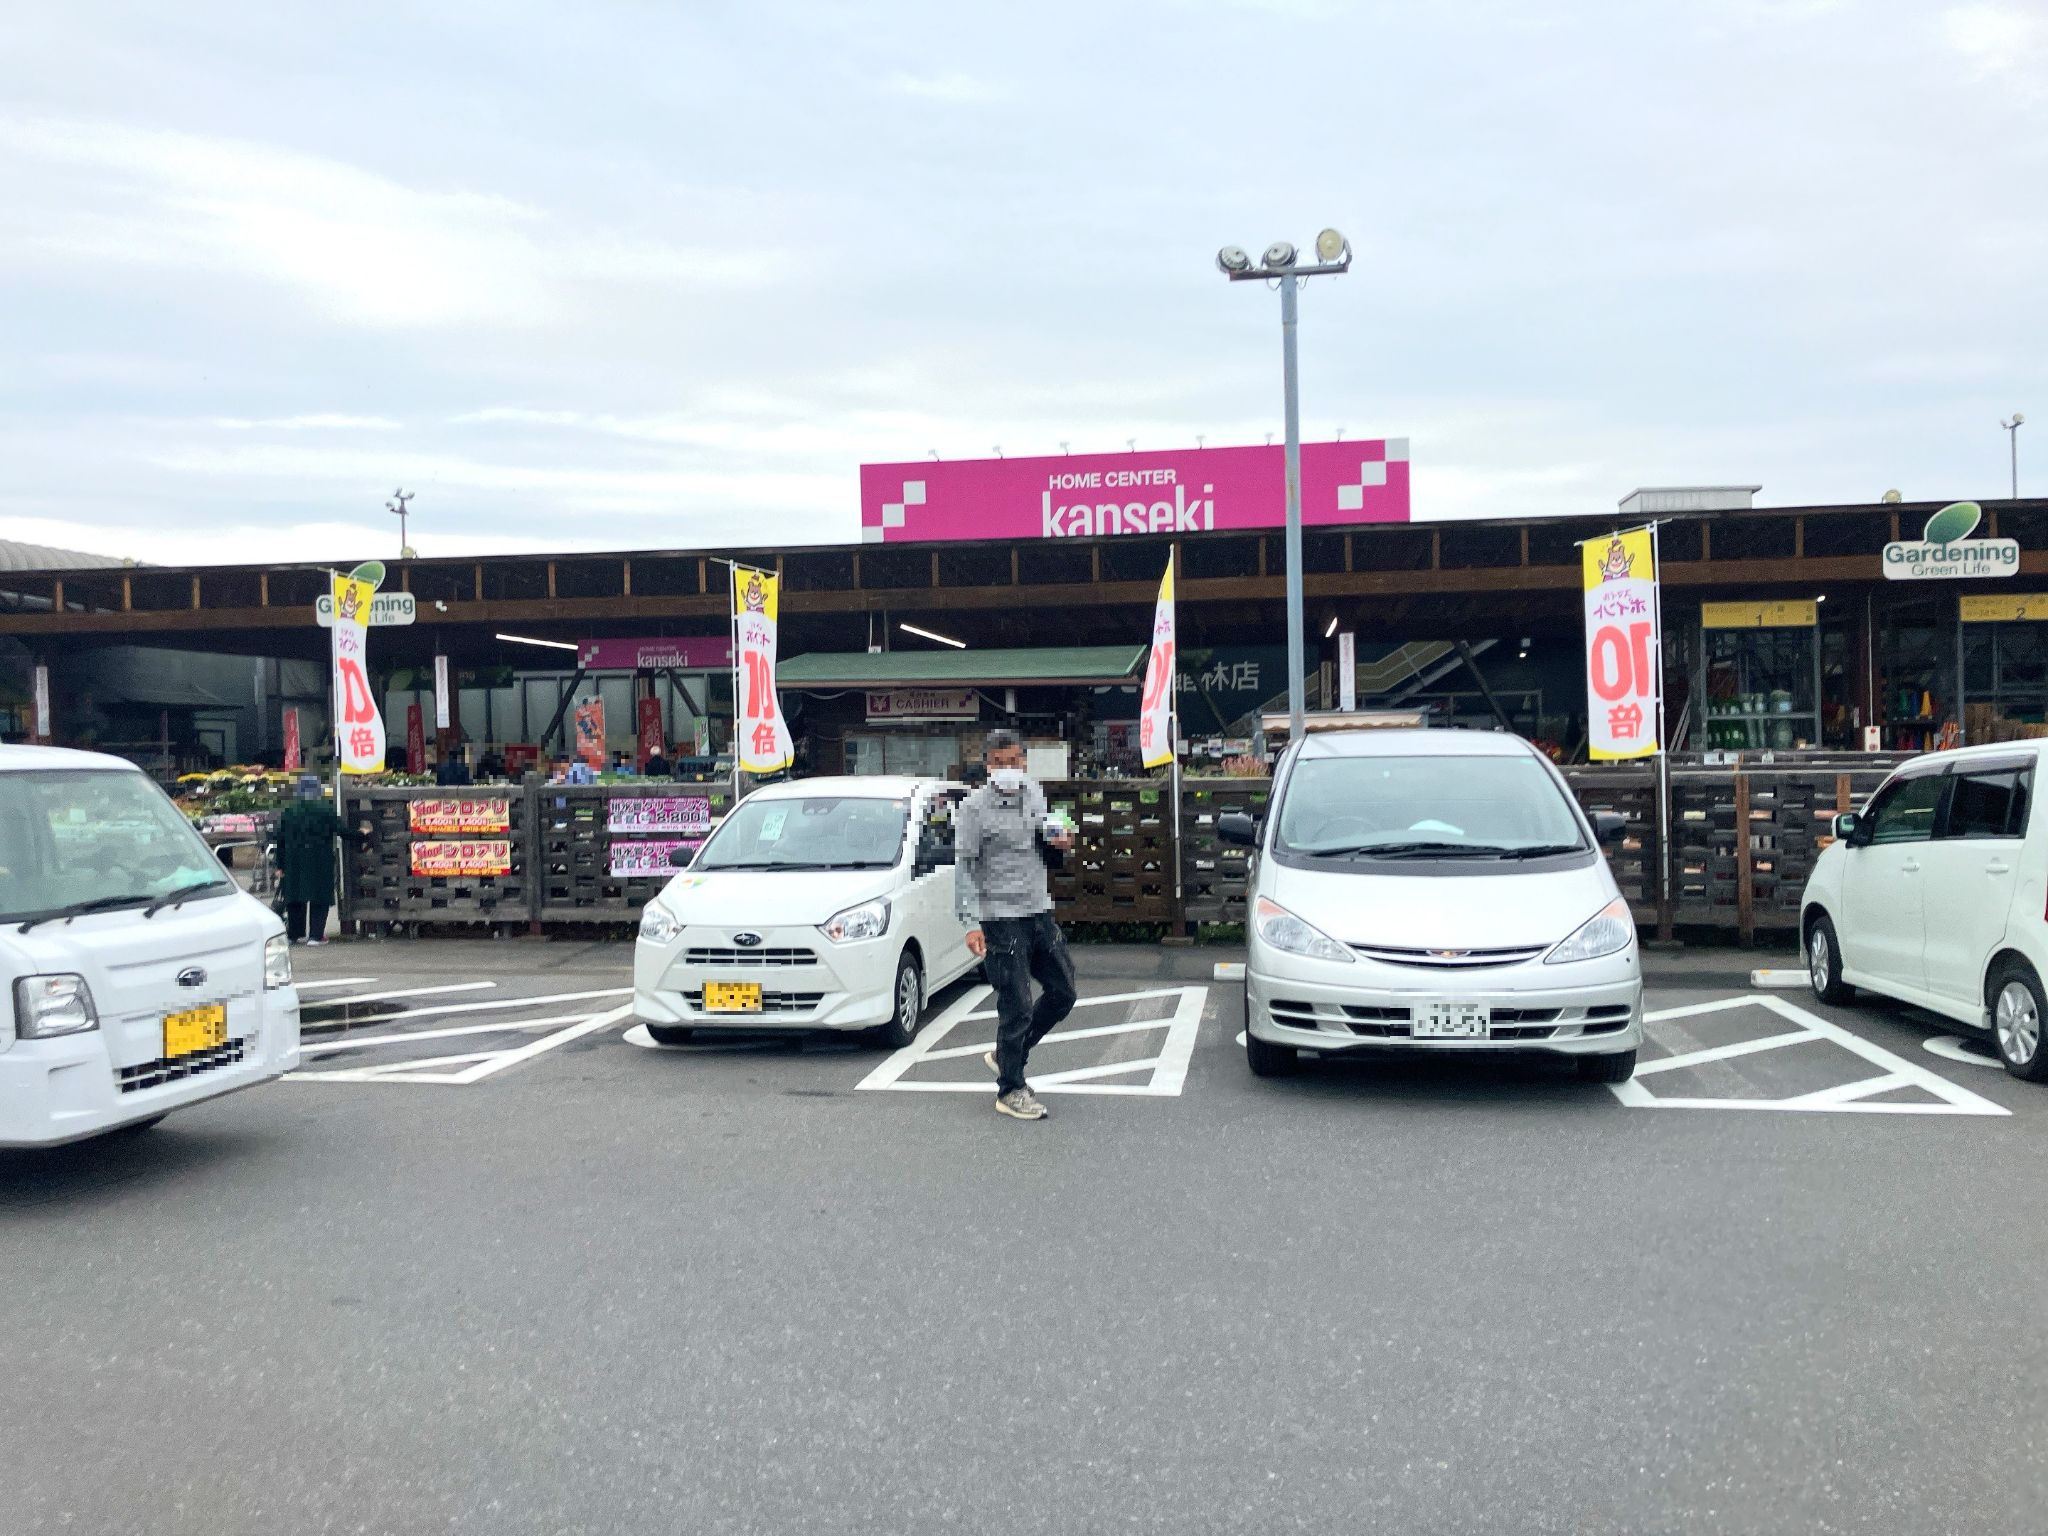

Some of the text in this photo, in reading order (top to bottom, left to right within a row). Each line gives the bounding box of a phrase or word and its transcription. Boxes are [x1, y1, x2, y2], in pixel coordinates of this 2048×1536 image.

[1050, 469, 1177, 489] HOME CENTER
[1042, 484, 1214, 537] kanseki
[1885, 542, 2017, 564] Gardening
[1911, 562, 1991, 577] Green Life
[318, 595, 413, 615] Gning
[2016, 607, 2026, 621] 2
[637, 650, 689, 668] kanseki
[351, 728, 375, 757] 倍
[752, 723, 776, 754] 倍
[443, 800, 506, 815] シロアリ
[444, 843, 508, 858] シロアリ
